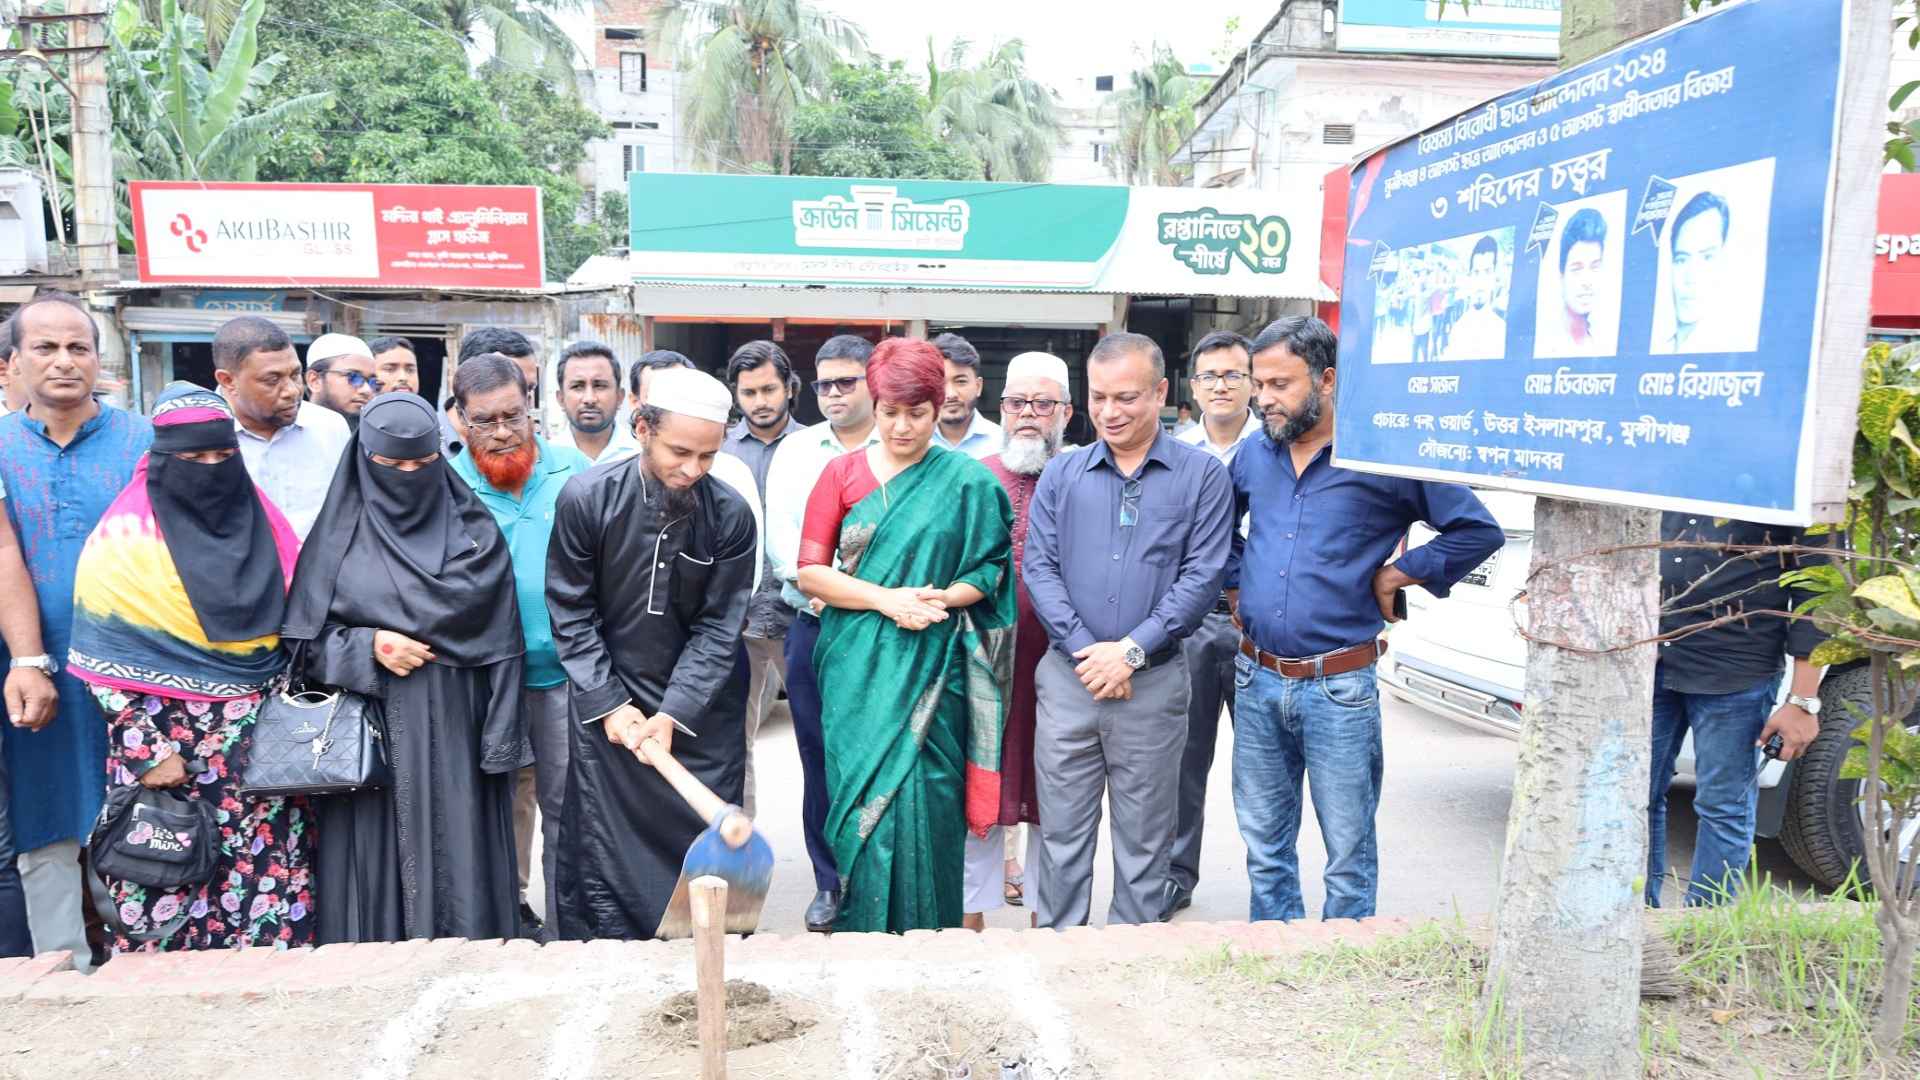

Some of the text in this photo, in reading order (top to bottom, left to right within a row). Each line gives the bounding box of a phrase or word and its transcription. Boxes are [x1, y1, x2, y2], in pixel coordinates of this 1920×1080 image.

[1417, 48, 1667, 155] বৈষম্য বিরোধী ছাত্র আন্দোলন ২০২৪
[1419, 168, 1427, 182] ৪
[1460, 151, 1481, 172] ছাত্র
[1482, 131, 1536, 162] আন্দোলন
[1537, 128, 1548, 146] ও
[1550, 124, 1560, 142] ৫
[1607, 83, 1682, 125] স্বাধীনতার
[1683, 66, 1736, 101] বিজয়
[1430, 196, 1448, 219] ৩
[1456, 167, 1544, 212] শহিদের
[799, 202, 963, 232] ক্রাউন সিমেন্ট
[1163, 212, 1242, 241] রপ্তানিতে
[303, 242, 353, 256] GLSS
[1178, 243, 1229, 270] শীর্ষে
[1239, 219, 1286, 268] ২০
[1408, 376, 1428, 394] মোঃ
[1524, 373, 1552, 395] মোঃ
[1638, 363, 1765, 408] মোঃ রিয়াজুল
[1483, 410, 1520, 434] উত্তর
[1475, 444, 1510, 466] স্বপন
[1513, 447, 1565, 471] মাদবর
[149, 839, 183, 851] mine
[154, 827, 174, 839] it's
